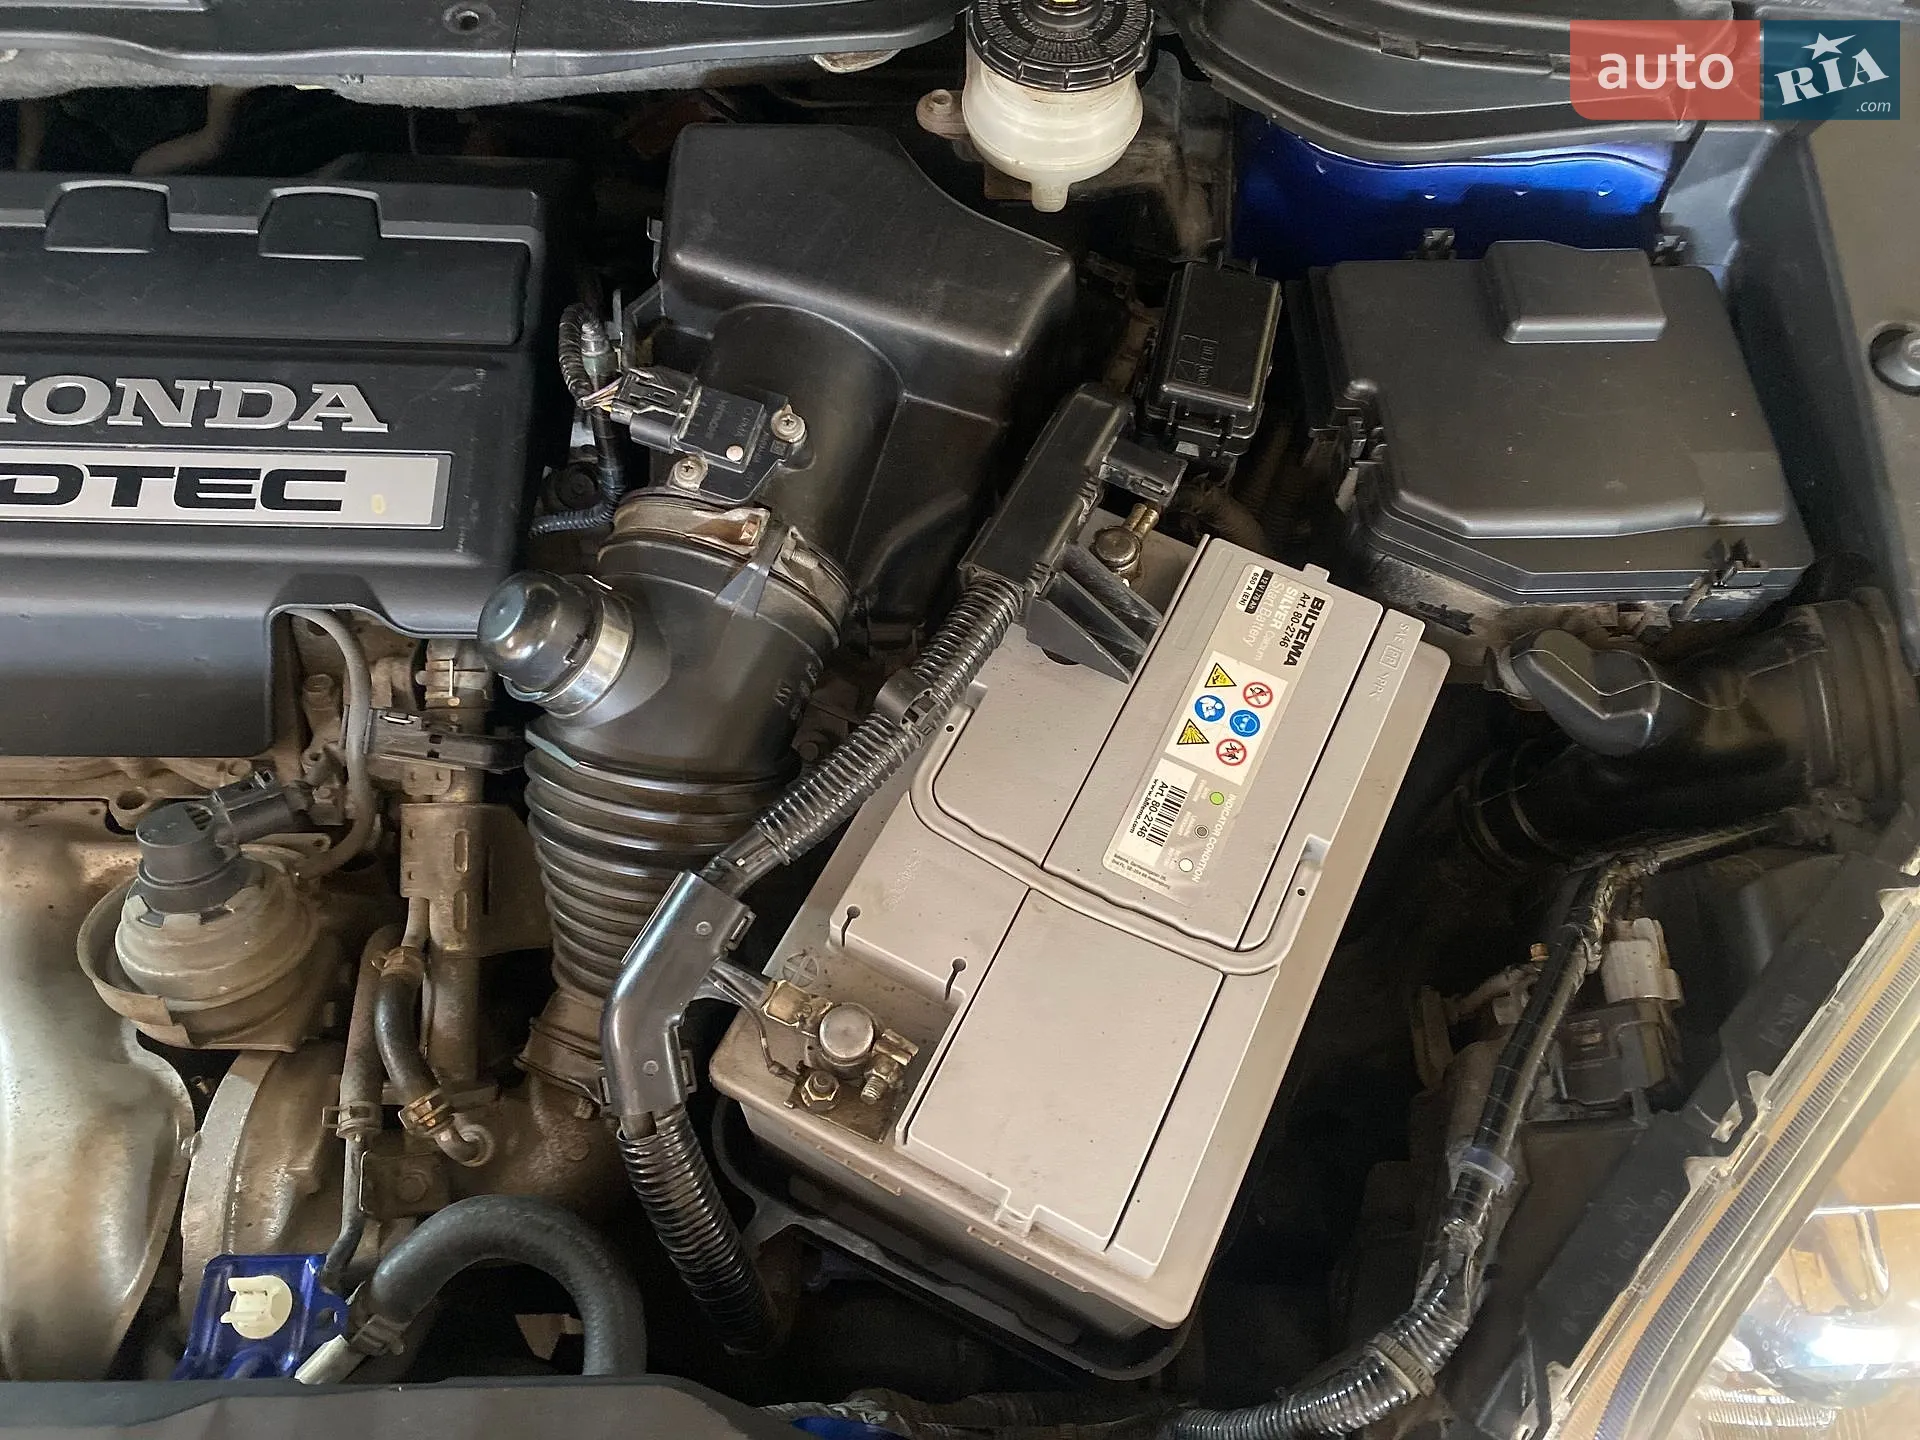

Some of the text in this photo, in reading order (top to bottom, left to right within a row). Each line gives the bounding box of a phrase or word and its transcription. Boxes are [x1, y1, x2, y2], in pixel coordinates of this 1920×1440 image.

[1268, 585, 1299, 630] SILVER
[1278, 591, 1311, 648] Art. 80-2746
[1281, 595, 1327, 669] BILTEMA
[1136, 781, 1169, 838] Art. 80-2746
[1210, 793, 1238, 837] INDICATOR
[1189, 835, 1218, 882] CONDITION
